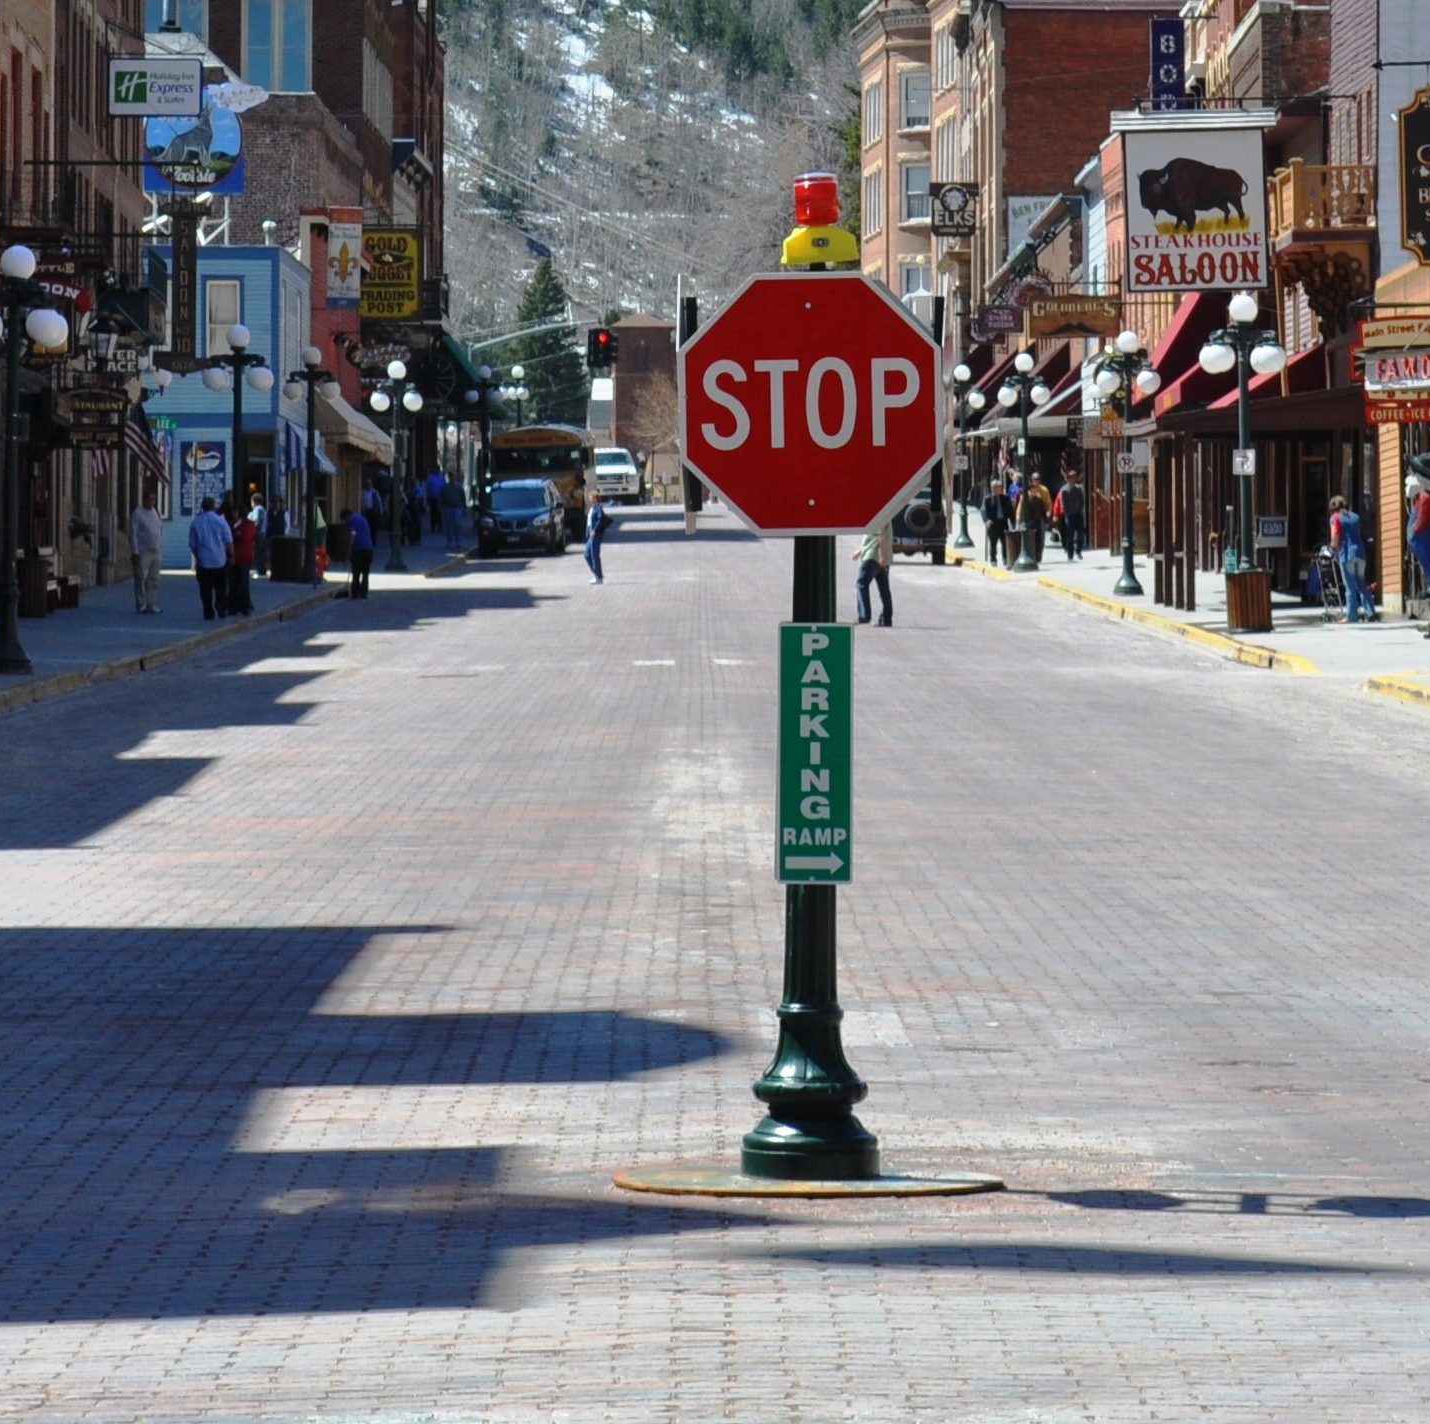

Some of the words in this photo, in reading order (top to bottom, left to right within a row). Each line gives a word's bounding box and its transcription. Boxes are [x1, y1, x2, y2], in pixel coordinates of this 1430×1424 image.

[150, 71, 181, 81] Holiday
[182, 72, 195, 80] Inn
[149, 83, 194, 94] Express
[163, 96, 185, 104] Suites
[934, 211, 975, 226] ELKS
[365, 236, 408, 252] GOLD
[1131, 231, 1263, 250] STEAKHOUSE
[35, 262, 75, 274] TYLE
[179, 219, 189, 321] SALOON
[363, 260, 414, 281] UGGET
[1134, 251, 1262, 287] SALOON
[367, 302, 404, 314] POST
[1387, 324, 1415, 335] Street
[176, 338, 191, 353] 10
[87, 361, 137, 372] PACE
[700, 357, 920, 451] STOP
[1371, 409, 1404, 420] COFFEE
[1411, 408, 1425, 419] ICE
[156, 419, 170, 429] LEE
[799, 632, 831, 820] PARKING
[783, 827, 847, 846] RAMP
